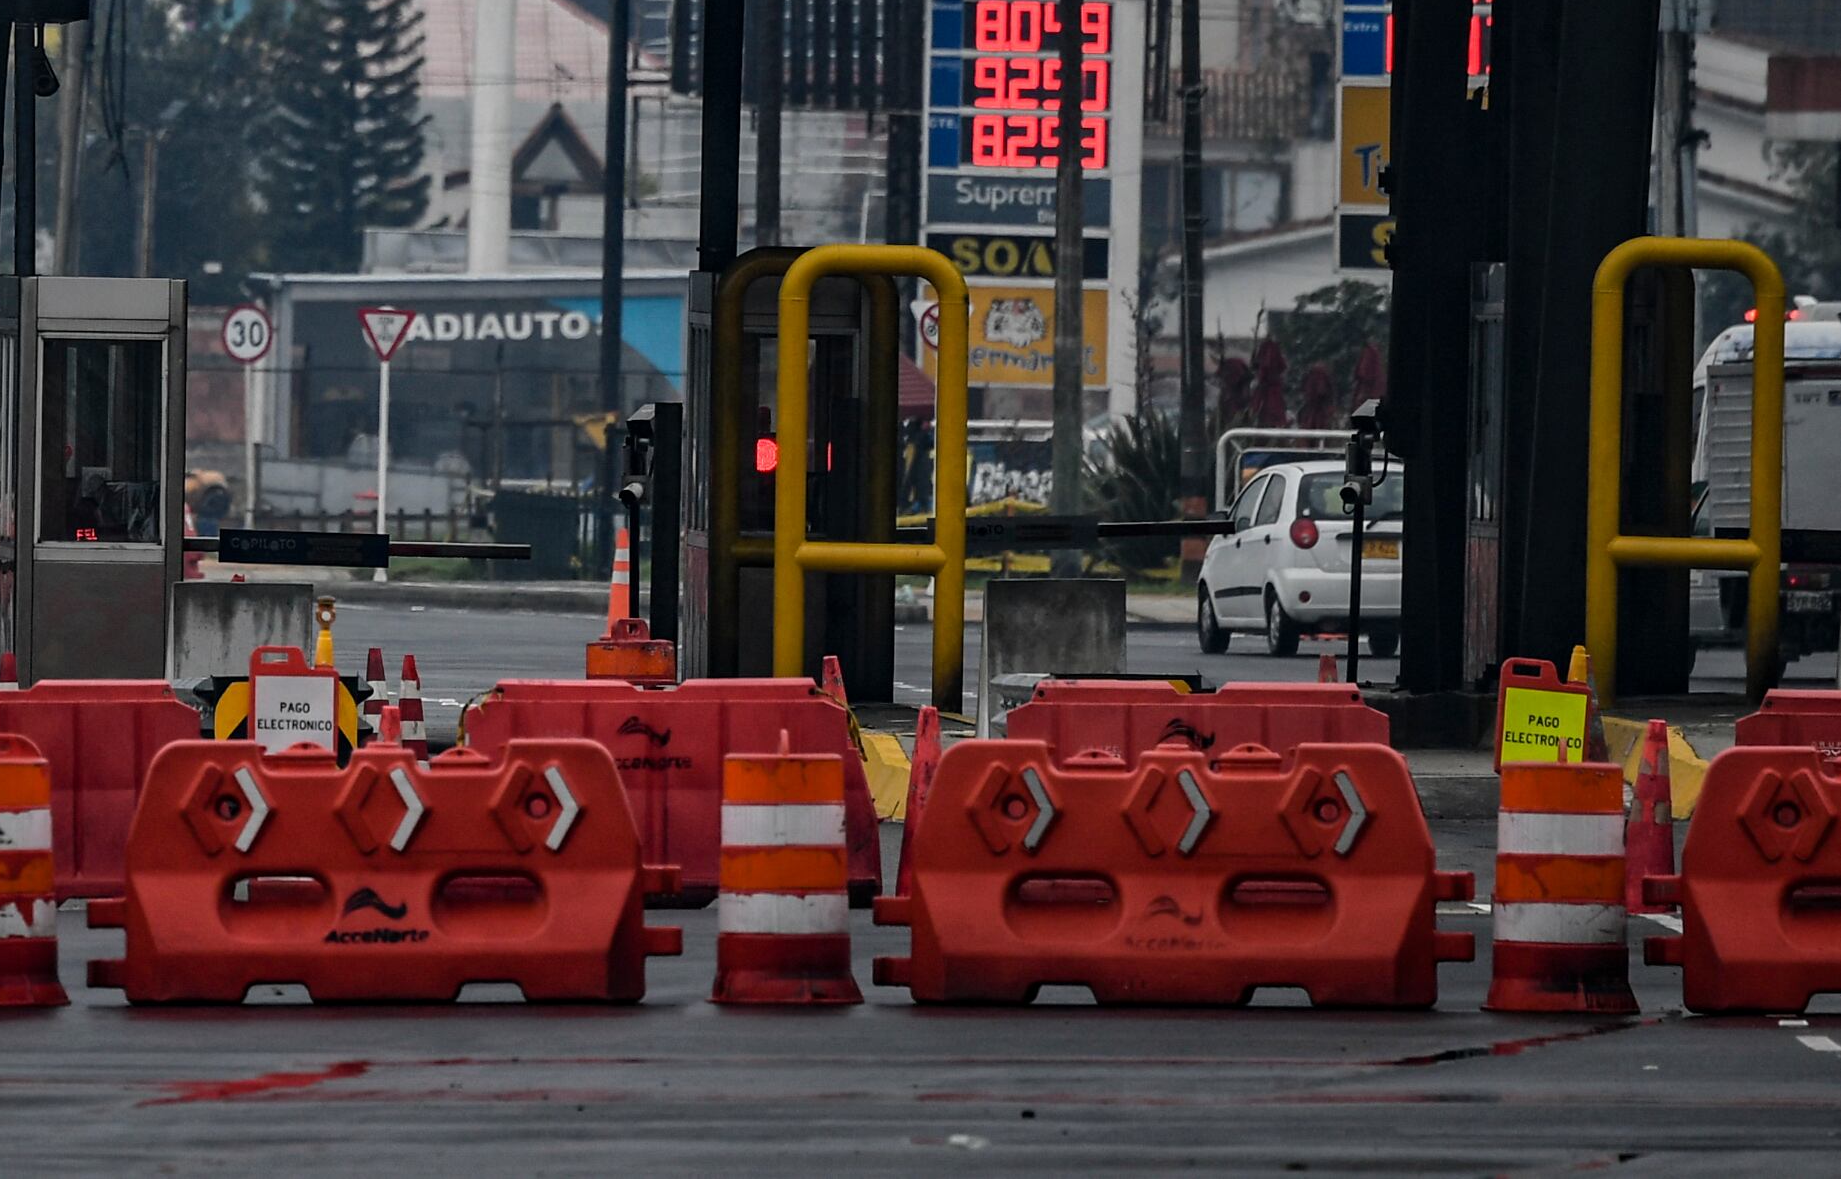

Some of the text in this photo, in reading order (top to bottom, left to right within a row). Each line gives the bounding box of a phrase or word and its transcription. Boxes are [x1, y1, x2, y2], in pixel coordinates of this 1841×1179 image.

[955, 178, 1057, 212] Suprem
[952, 236, 1058, 276] SOA
[231, 320, 263, 349] 30
[405, 311, 603, 341] ADIAUTO
[279, 702, 311, 714] PAGO
[257, 718, 333, 732] ELECTRONICO
[1527, 714, 1560, 729] PAGO
[1504, 730, 1582, 749] ELECTRONCO
